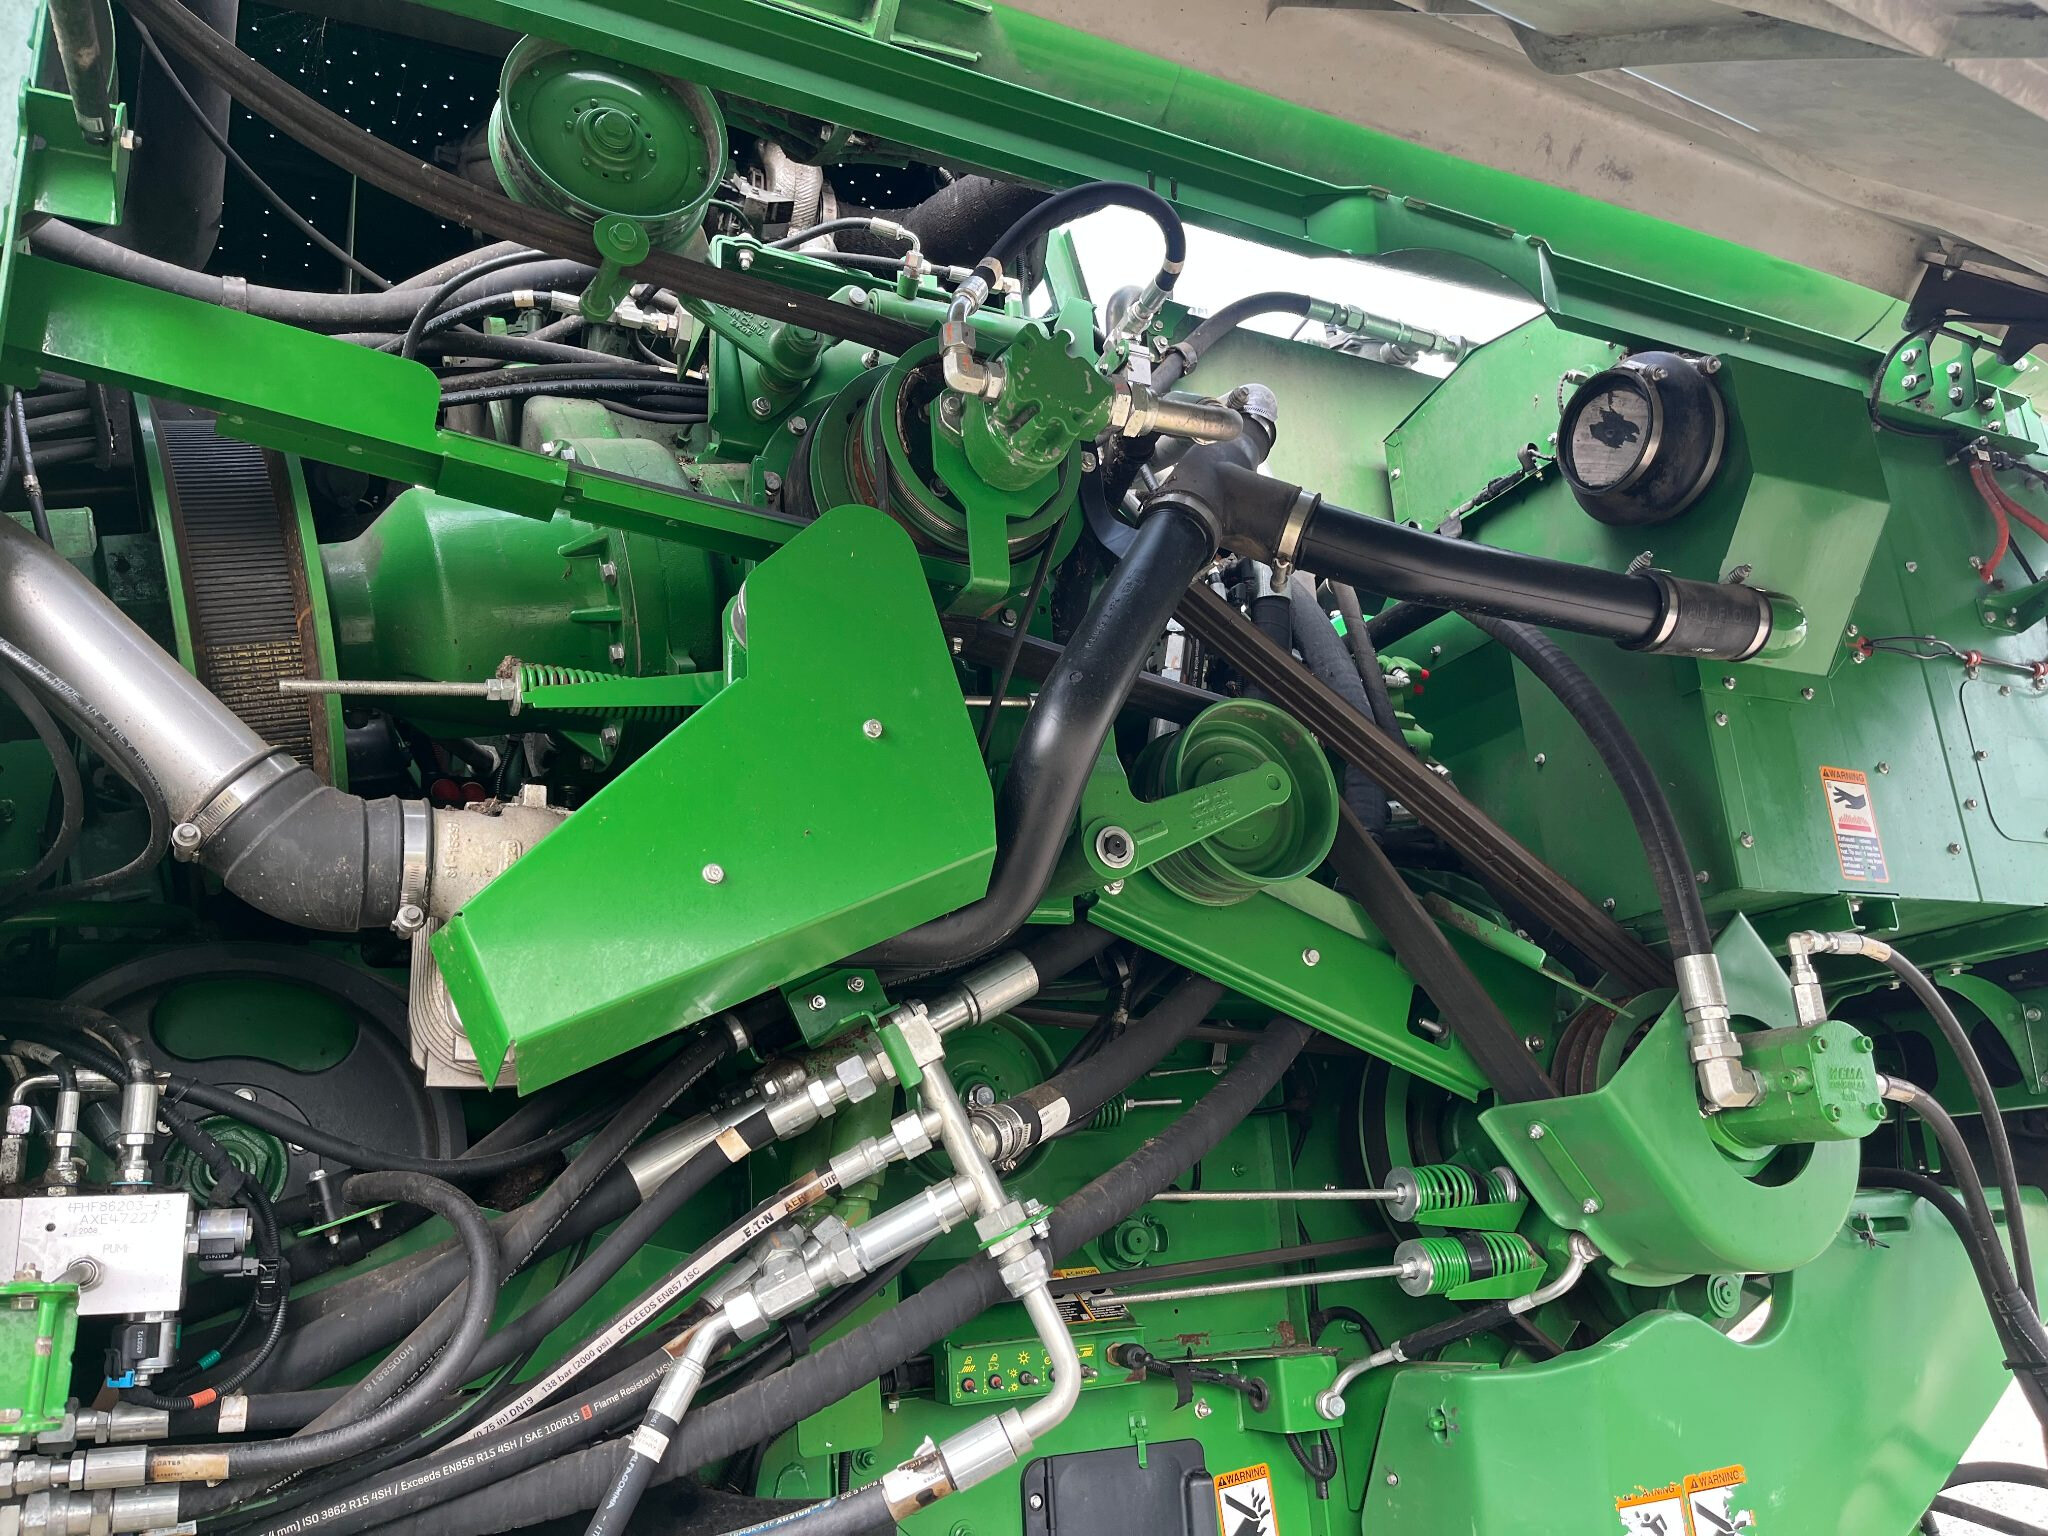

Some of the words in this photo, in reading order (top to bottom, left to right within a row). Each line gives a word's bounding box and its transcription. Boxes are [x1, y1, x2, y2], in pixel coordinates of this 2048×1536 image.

[86, 704, 101, 718] IN
[104, 721, 133, 750] ITALY
[1829, 769, 1865, 782] WARNING
[80, 1209, 159, 1225] AXE47227
[509, 1396, 535, 1418] DN19
[541, 1380, 558, 1394] 138
[558, 1368, 573, 1383] bar
[573, 1350, 596, 1371] (2000
[597, 1337, 612, 1354] psi)
[618, 1301, 657, 1335] EXCEEDS
[656, 1280, 682, 1304] EN857
[682, 1267, 701, 1283] 1SC
[364, 1344, 415, 1392] H0058818
[156, 1459, 181, 1467] GATES
[302, 1512, 320, 1528] ISO
[321, 1503, 348, 1521] 3862
[349, 1494, 370, 1510] R15
[371, 1485, 393, 1502] 4SH
[400, 1468, 442, 1492] Exceeds
[442, 1457, 476, 1476] EN856
[476, 1448, 497, 1463] R15
[497, 1439, 518, 1455] 4SH
[524, 1428, 544, 1444] SAE
[544, 1412, 581, 1435] 100R15
[593, 1393, 620, 1412] Flame
[619, 1372, 658, 1398] Resistant
[605, 1452, 639, 1510] ALFAGOMMA
[1226, 1466, 1266, 1485] WARNING
[1698, 1469, 1740, 1487] WARNING
